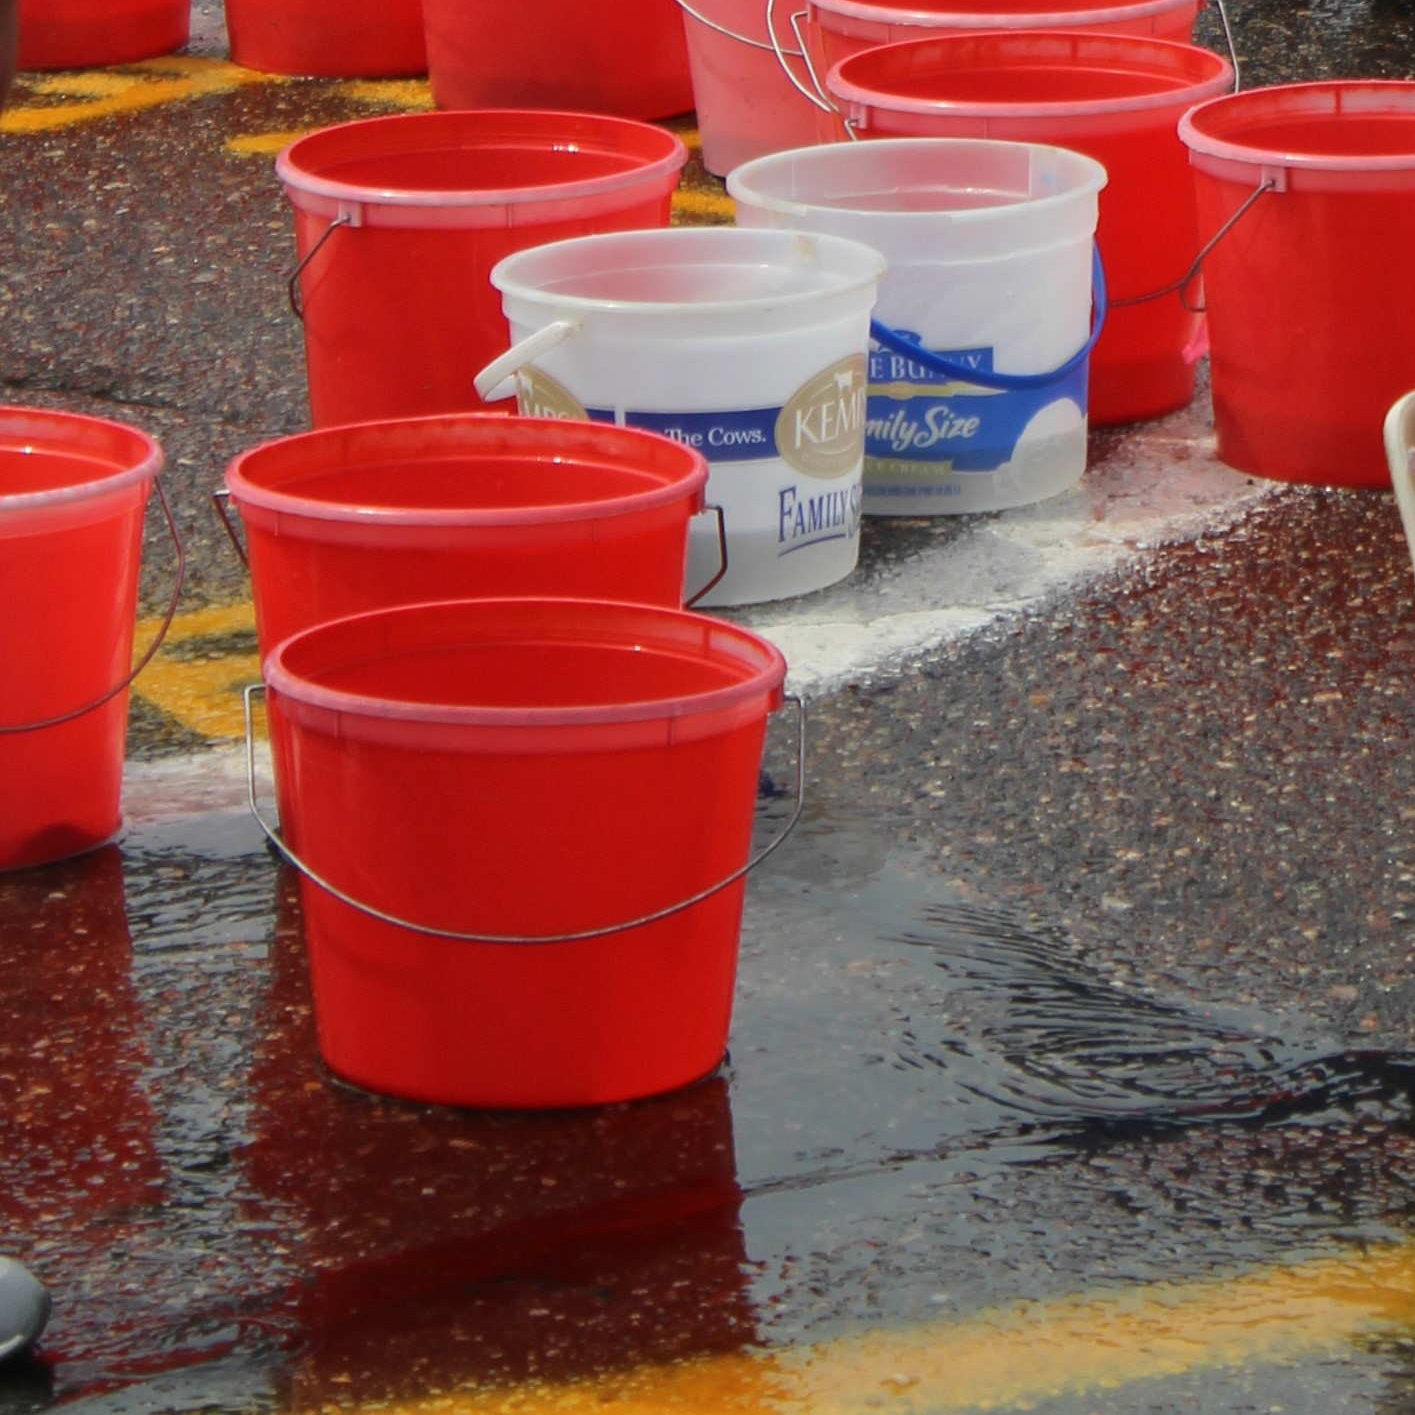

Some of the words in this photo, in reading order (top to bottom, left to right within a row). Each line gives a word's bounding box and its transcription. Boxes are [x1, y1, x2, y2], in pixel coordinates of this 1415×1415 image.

[664, 428, 704, 447] The
[707, 427, 767, 447] Cows.
[866, 409, 918, 452] mily
[913, 406, 981, 449] Size
[777, 484, 850, 543] FAMILY
